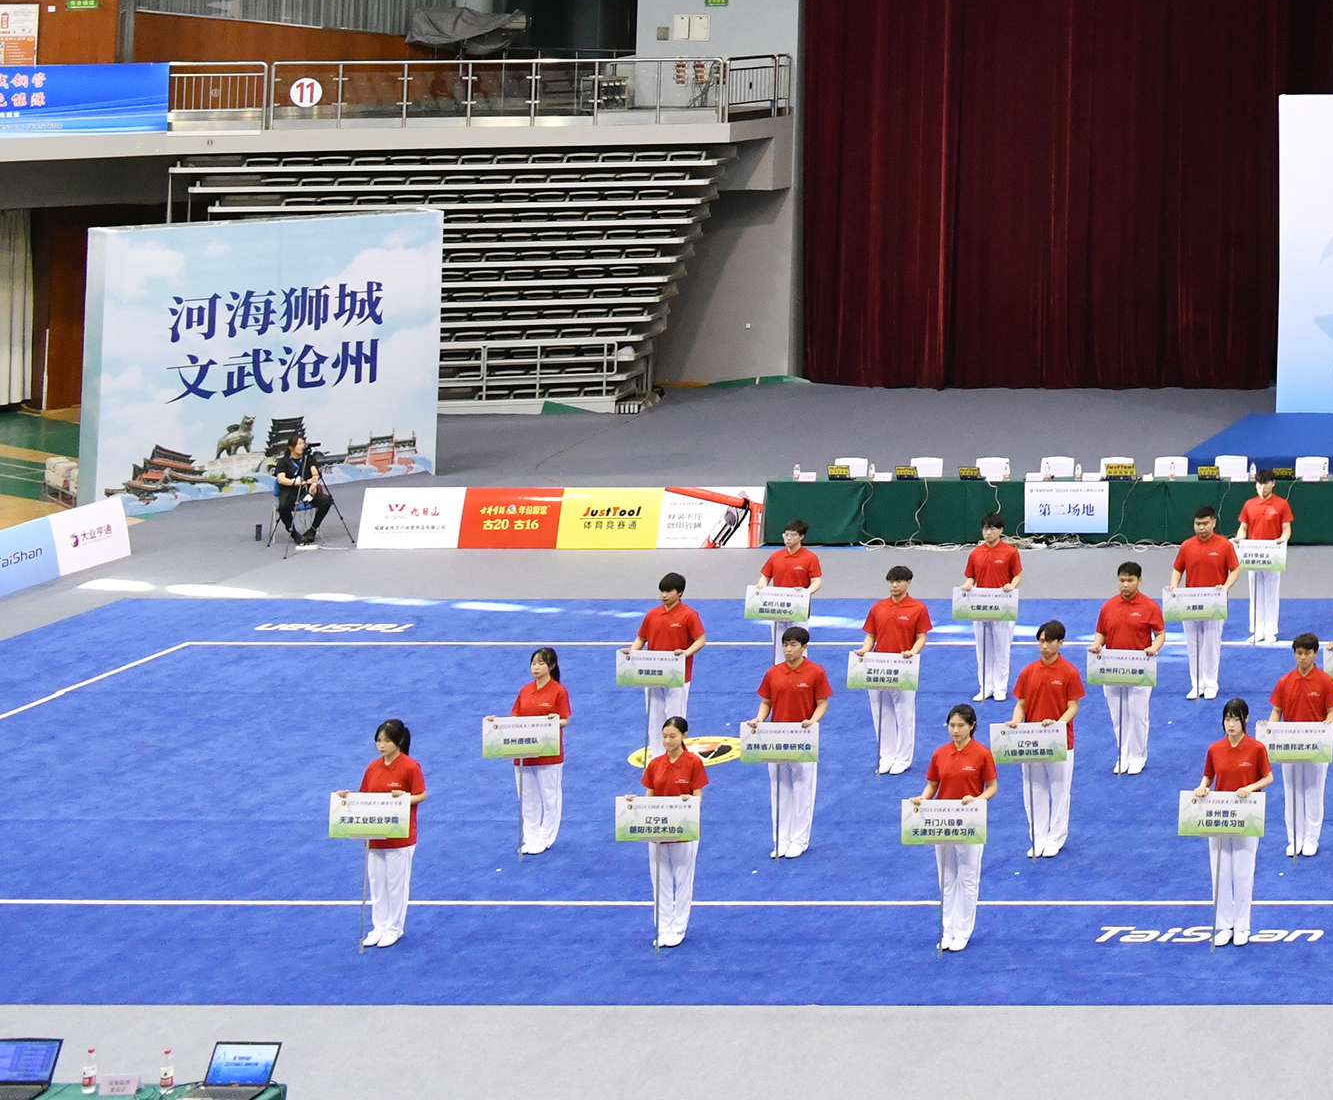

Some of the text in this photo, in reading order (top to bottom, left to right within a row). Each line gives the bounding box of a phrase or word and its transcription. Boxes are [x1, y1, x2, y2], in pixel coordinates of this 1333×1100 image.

[295, 82, 318, 105] 11
[168, 281, 384, 343] 河海狮城
[165, 338, 380, 405] 文武沧州
[410, 506, 440, 517] 九日山
[583, 506, 642, 517] JustTool
[1038, 503, 1095, 517] 第二场地
[483, 519, 540, 530] 古20 古16
[583, 520, 637, 530] 体育竞赛通
[81, 524, 112, 541] 大业亨通
[0, 547, 43, 568] aiShan
[340, 816, 399, 824] 天津工业职业学院
[629, 826, 683, 834] 朝阳市武术协会
[1095, 926, 1324, 942] TaiSan
